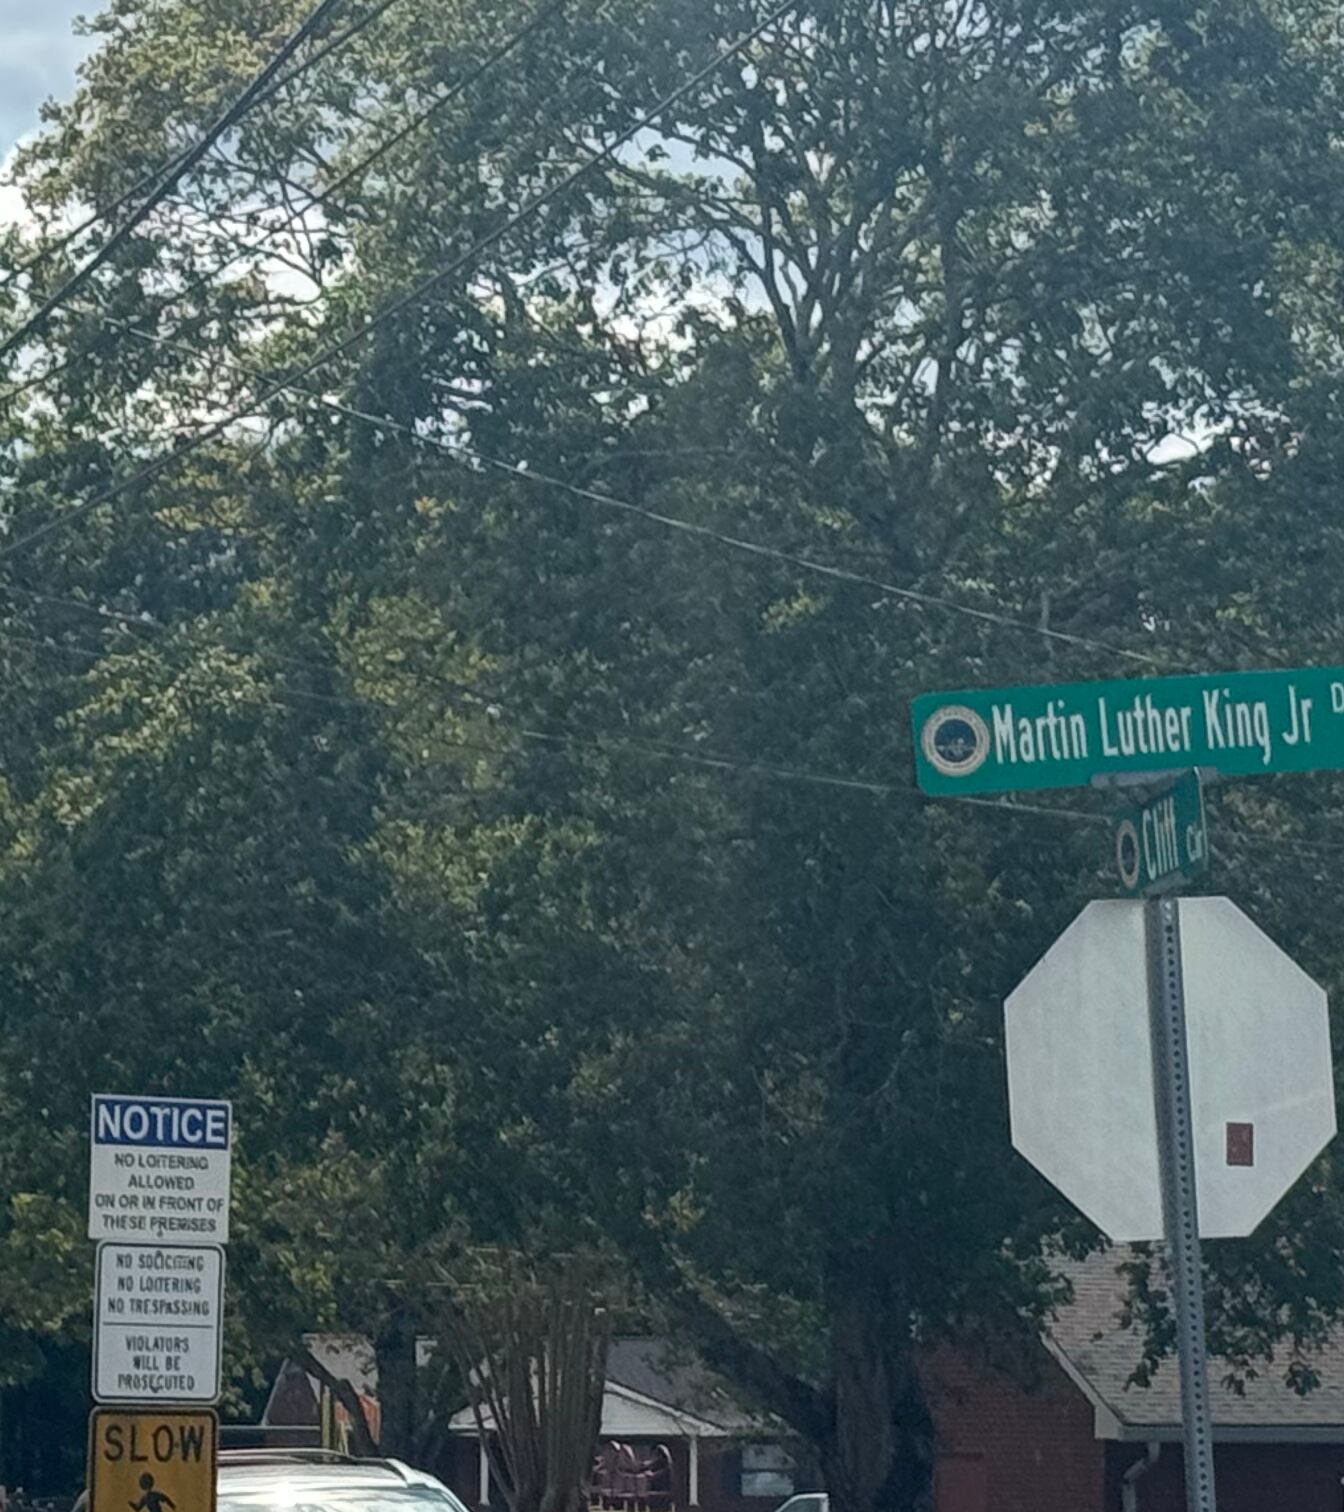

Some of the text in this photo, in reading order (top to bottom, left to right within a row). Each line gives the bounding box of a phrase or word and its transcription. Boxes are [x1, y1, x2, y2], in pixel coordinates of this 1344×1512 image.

[991, 701, 1088, 764] Martin
[1098, 695, 1192, 757] Luther
[1202, 688, 1272, 765] King
[1282, 685, 1313, 745] Jr
[98, 1104, 226, 1145] NOTICE
[114, 1153, 209, 1170] NO LOITERING
[128, 1174, 195, 1190] ALLOWED
[95, 1193, 224, 1213] ON OR IN FRONT OF
[102, 1214, 216, 1233] THESE PREMISES
[116, 1253, 132, 1269] NO
[117, 1276, 201, 1293] NO LOITERING
[108, 1298, 209, 1316] NO TRESPASSING
[125, 1336, 190, 1352] VIOLATORS
[133, 1356, 181, 1371] WILL BE
[118, 1374, 195, 1391] PROSECUTED
[103, 1425, 204, 1463] SLOW
